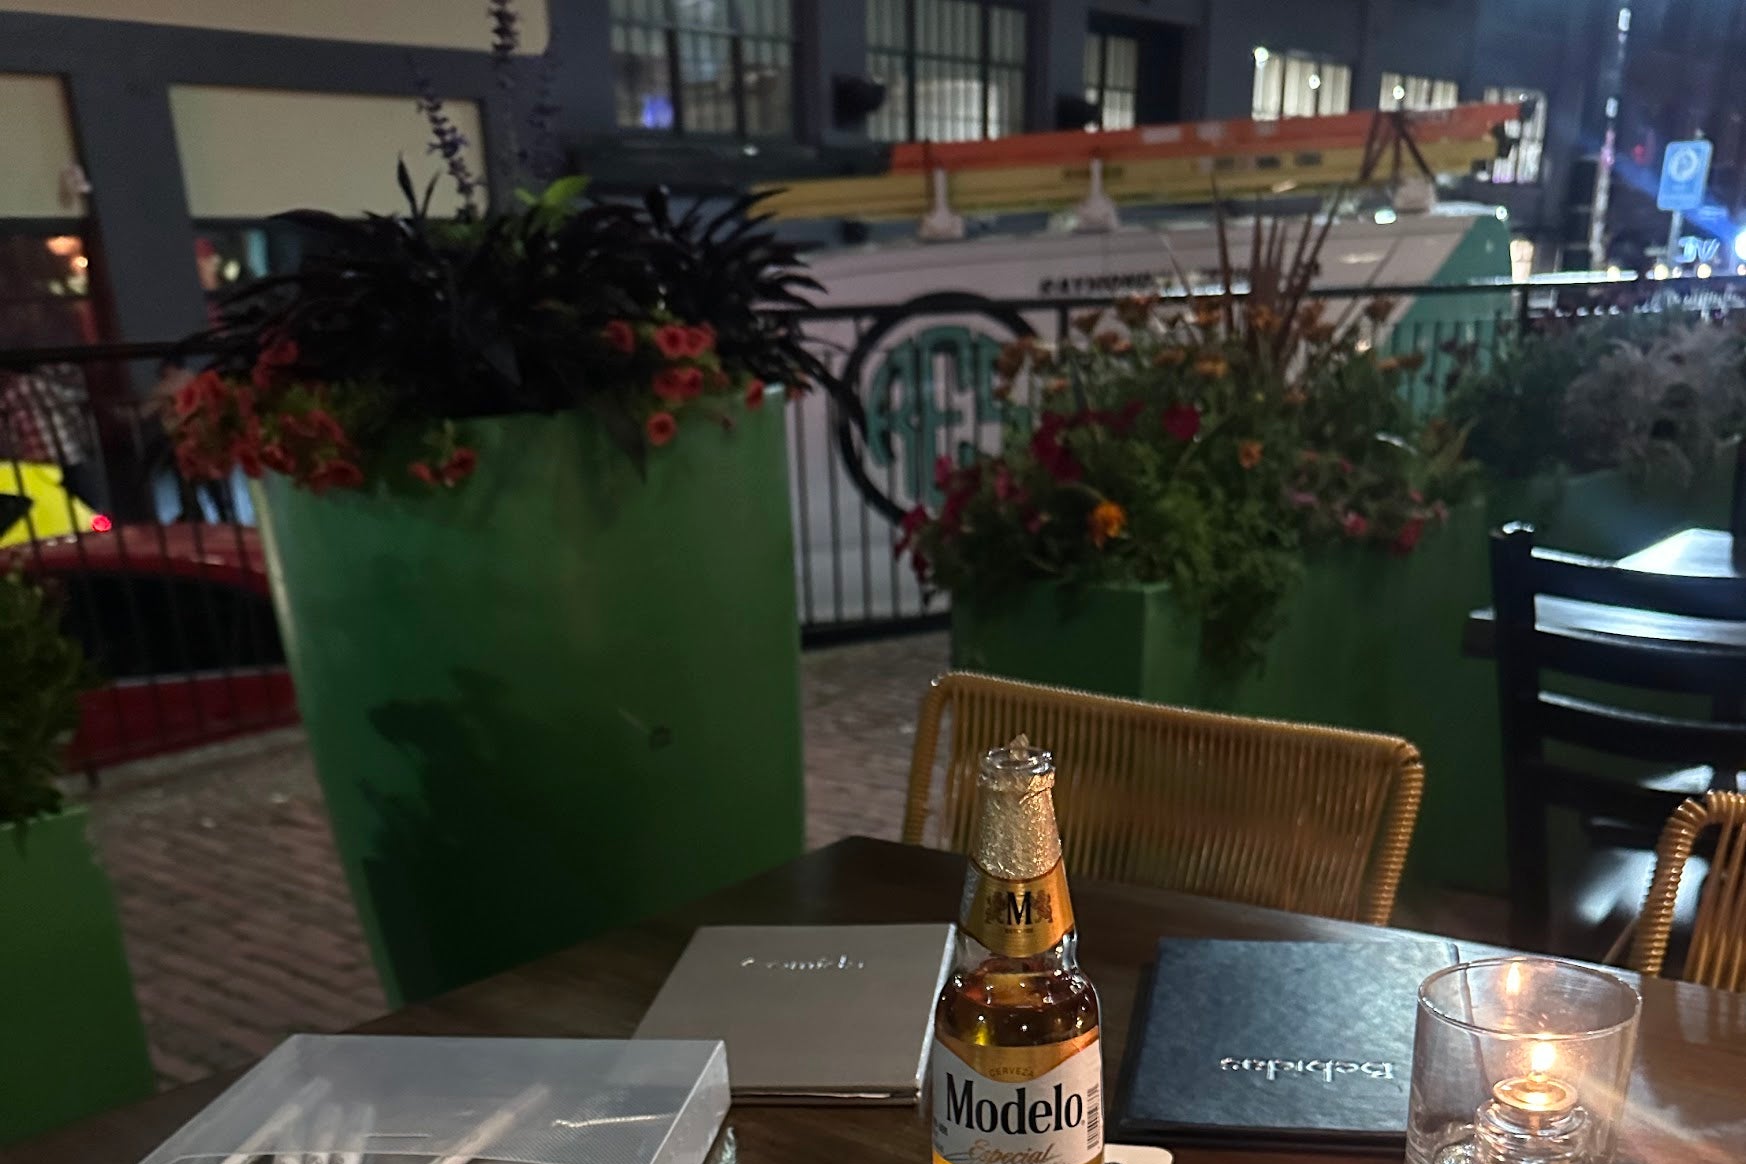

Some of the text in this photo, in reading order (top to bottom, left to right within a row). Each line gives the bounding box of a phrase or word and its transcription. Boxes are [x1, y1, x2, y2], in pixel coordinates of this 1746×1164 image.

[1007, 891, 1032, 926] M
[988, 1066, 1036, 1078] CERVEZA
[946, 1072, 1083, 1135] Modelo
